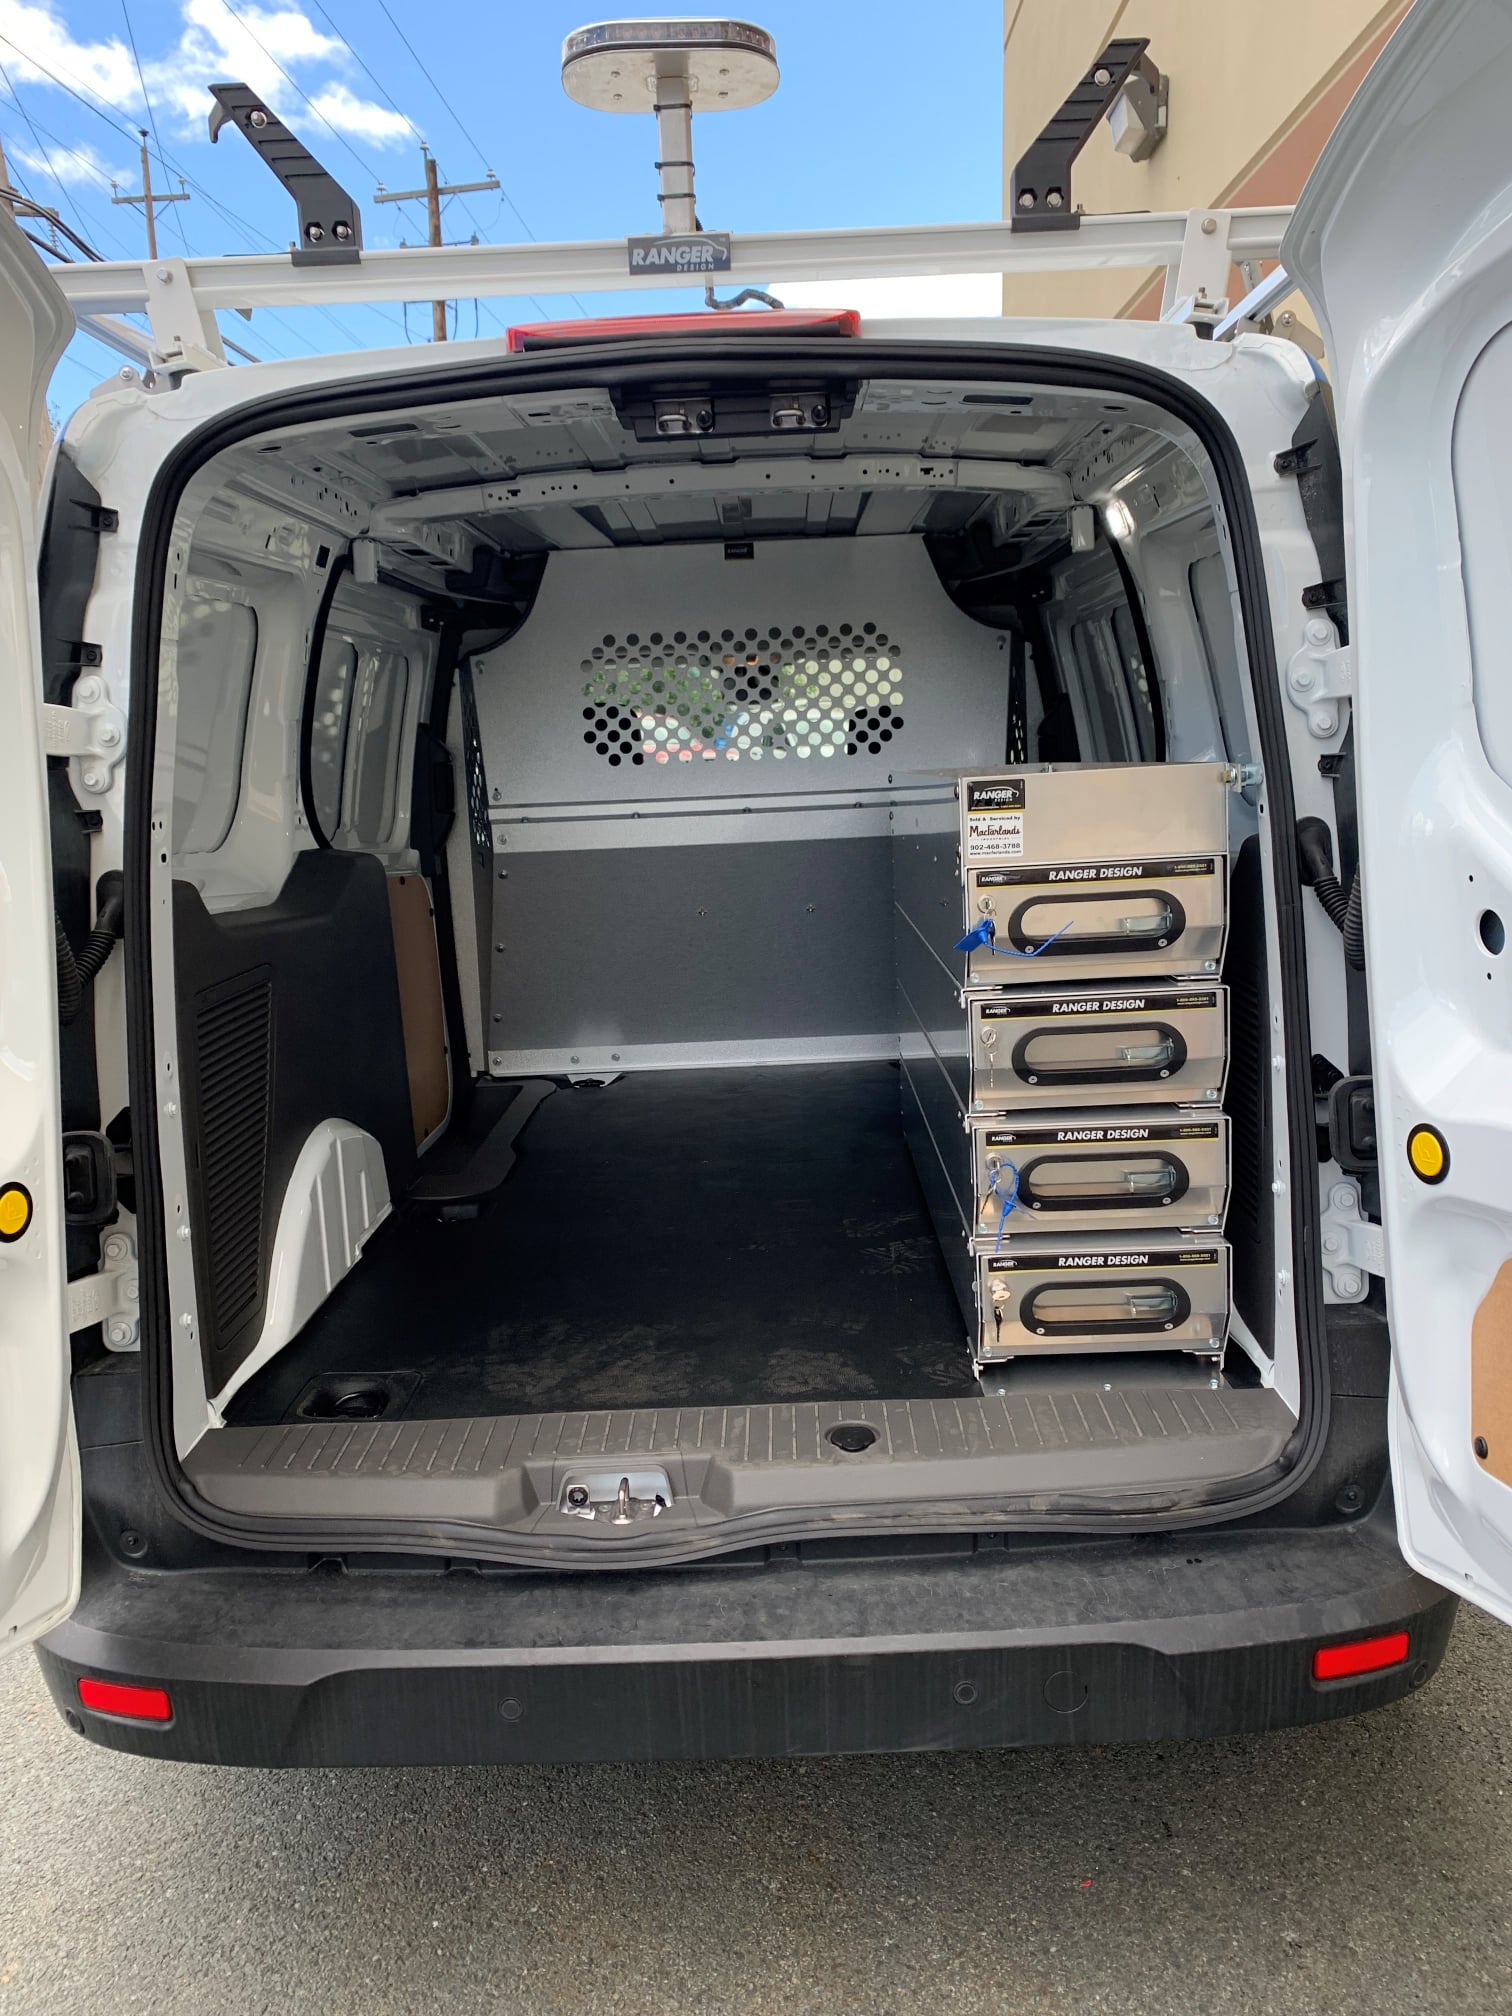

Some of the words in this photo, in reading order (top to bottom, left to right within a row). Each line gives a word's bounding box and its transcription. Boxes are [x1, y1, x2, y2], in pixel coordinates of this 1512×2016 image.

[632, 245, 714, 266] RANGER
[676, 263, 714, 272] DESIGN
[973, 790, 1012, 800] RANGER
[969, 824, 1020, 838] MacFarlands
[1048, 869, 1097, 881] RANGER
[1099, 866, 1143, 878] DESIGN
[1052, 1001, 1100, 1013] RANGER
[1102, 999, 1145, 1011] DESIGN
[1057, 1130, 1104, 1141] RANGER
[1106, 1128, 1149, 1139] DESIGN
[1058, 1256, 1105, 1267] RANGER
[1107, 1254, 1149, 1265] DESIGN
